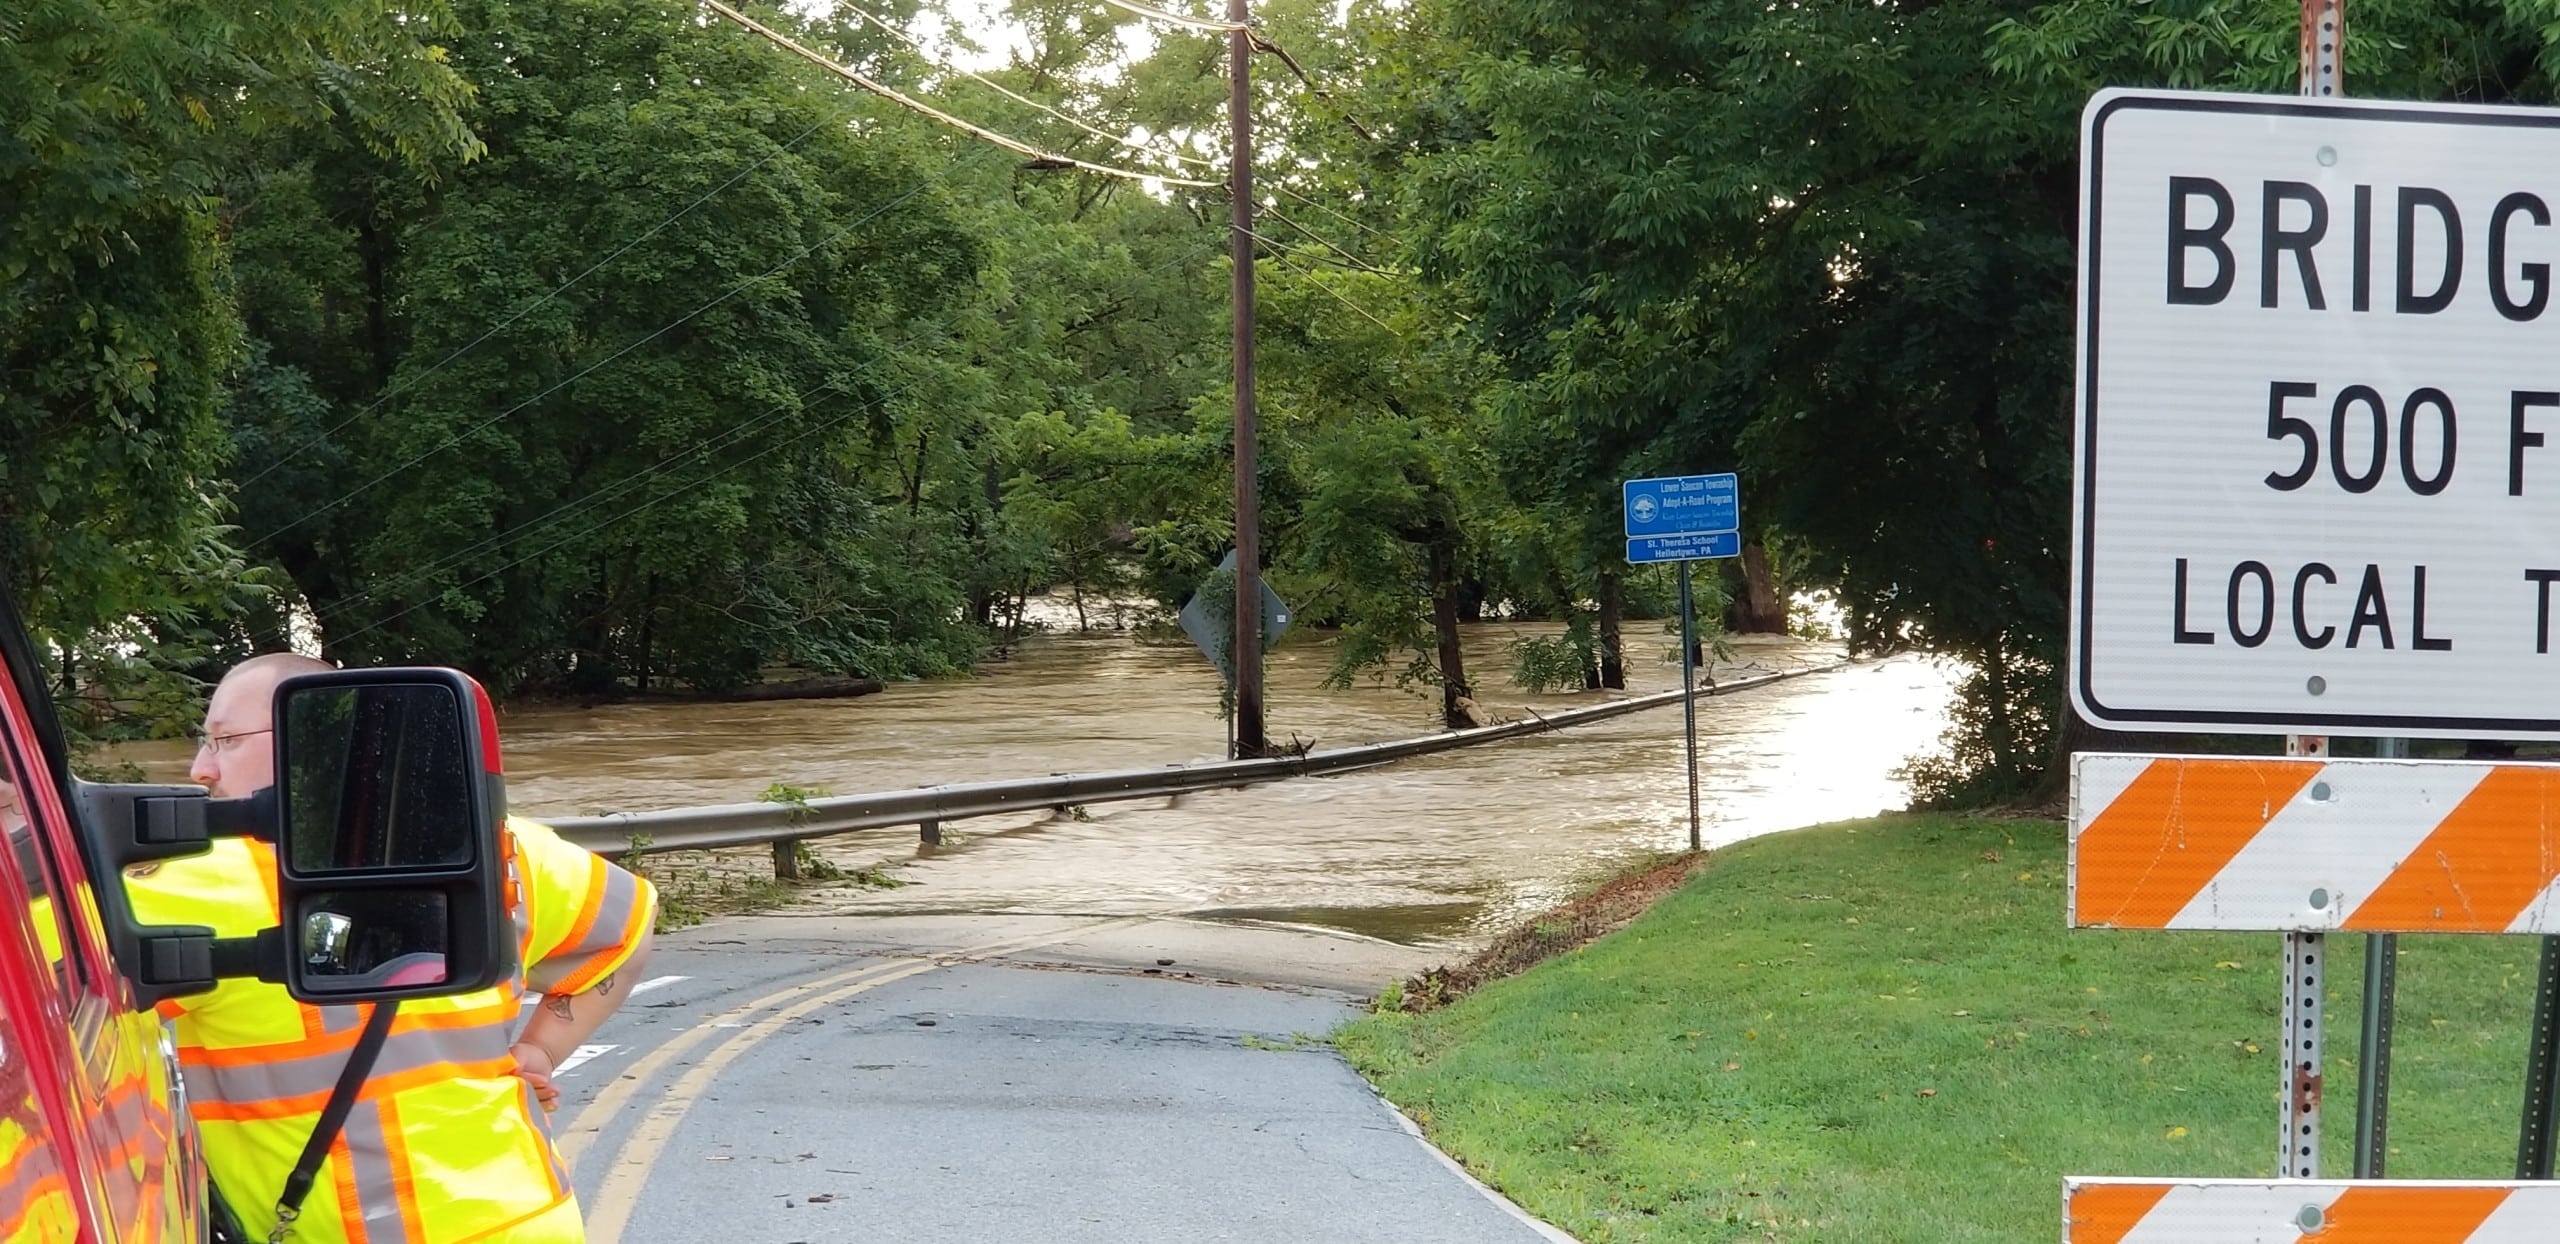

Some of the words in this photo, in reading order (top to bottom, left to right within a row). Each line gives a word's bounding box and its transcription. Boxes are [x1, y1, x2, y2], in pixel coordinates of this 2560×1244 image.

[2166, 175, 2552, 322] BRIDG
[2263, 380, 2458, 497] 500
[1660, 482, 1680, 493] Lower
[1706, 494, 1733, 506] Program
[1647, 539, 1659, 548] St.
[1692, 535, 1719, 545] School
[1700, 546, 1712, 555] PA
[2172, 557, 2454, 652] LOCAL
